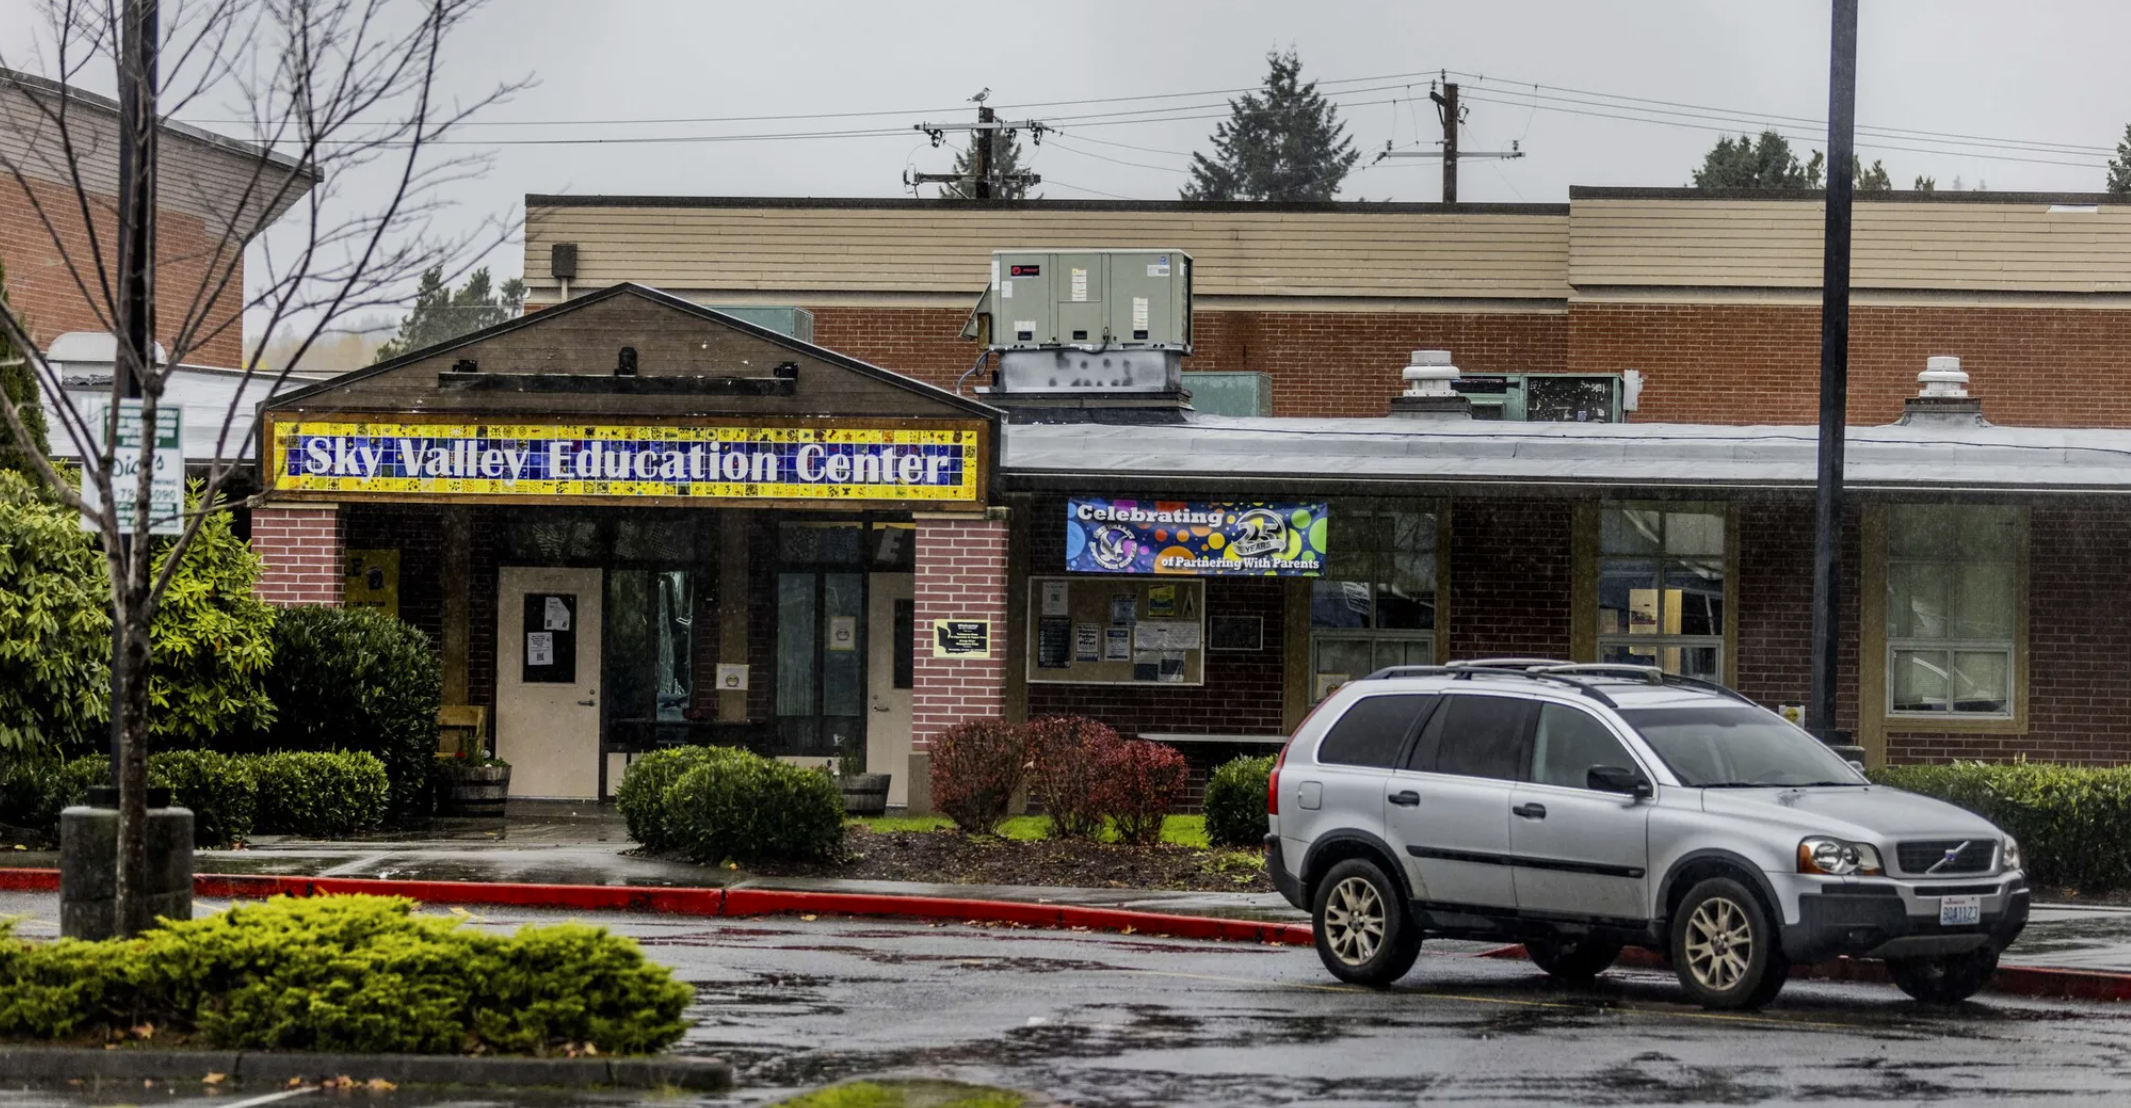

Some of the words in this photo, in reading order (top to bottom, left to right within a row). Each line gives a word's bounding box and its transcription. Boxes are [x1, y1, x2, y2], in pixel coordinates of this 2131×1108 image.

[306, 438, 383, 484] Sky
[400, 439, 530, 487] Valley
[549, 440, 778, 482] Education
[796, 444, 948, 484] Center
[1077, 504, 1225, 528] Celebrating
[1237, 521, 1279, 545] 25
[1245, 540, 1271, 554] YEARS
[1161, 556, 1174, 568] of
[1175, 557, 1242, 571] Partnering
[1242, 556, 1272, 569] With
[1273, 556, 1320, 569] Parents
